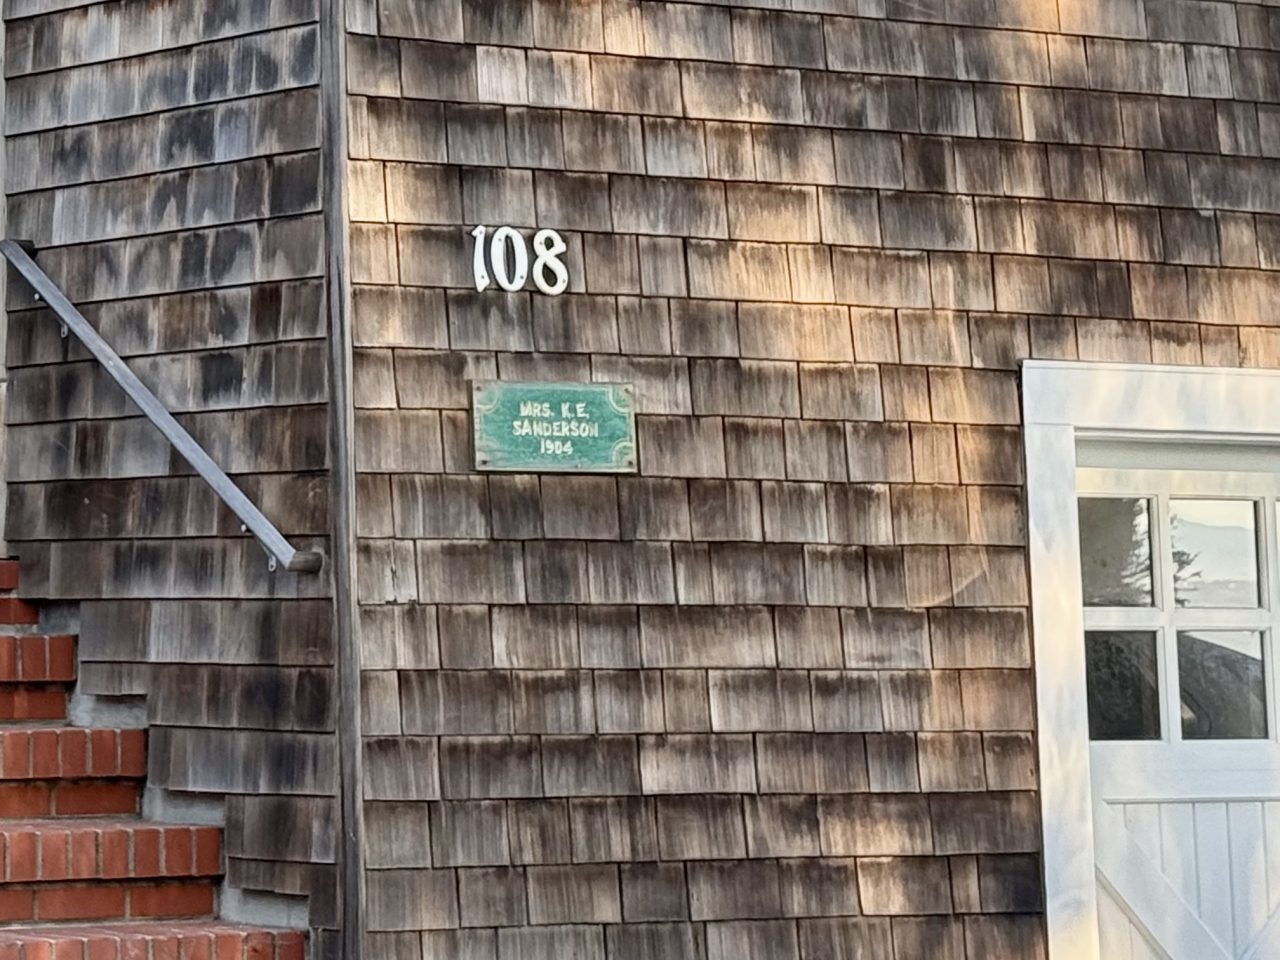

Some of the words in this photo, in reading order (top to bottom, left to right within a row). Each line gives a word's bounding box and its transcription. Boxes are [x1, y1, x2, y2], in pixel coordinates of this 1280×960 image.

[471, 225, 569, 295] 108
[519, 401, 555, 417] MRS.
[512, 420, 598, 437] SANDERSON
[540, 440, 573, 455] 1904
